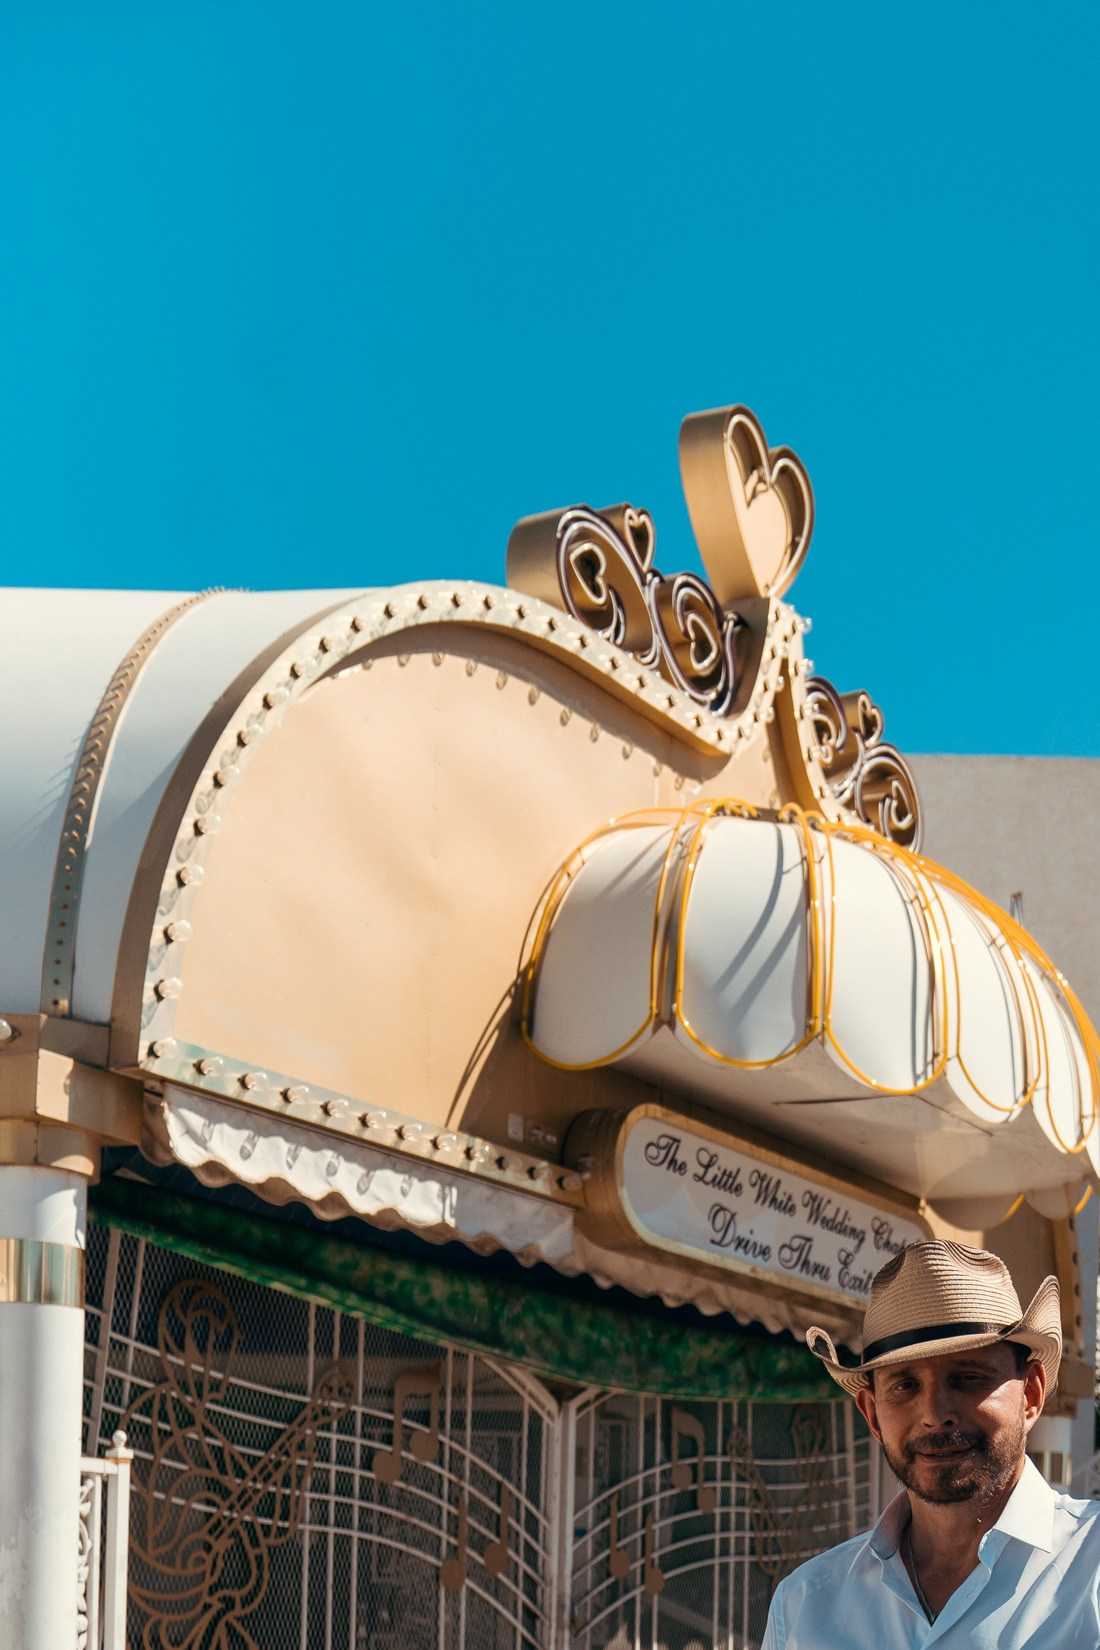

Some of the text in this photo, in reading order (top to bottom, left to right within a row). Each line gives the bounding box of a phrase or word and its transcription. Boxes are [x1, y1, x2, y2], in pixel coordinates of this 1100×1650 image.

[644, 1134, 906, 1256] The Little White Wedding Cha
[708, 1203, 873, 1295] Drive Thru Exit
